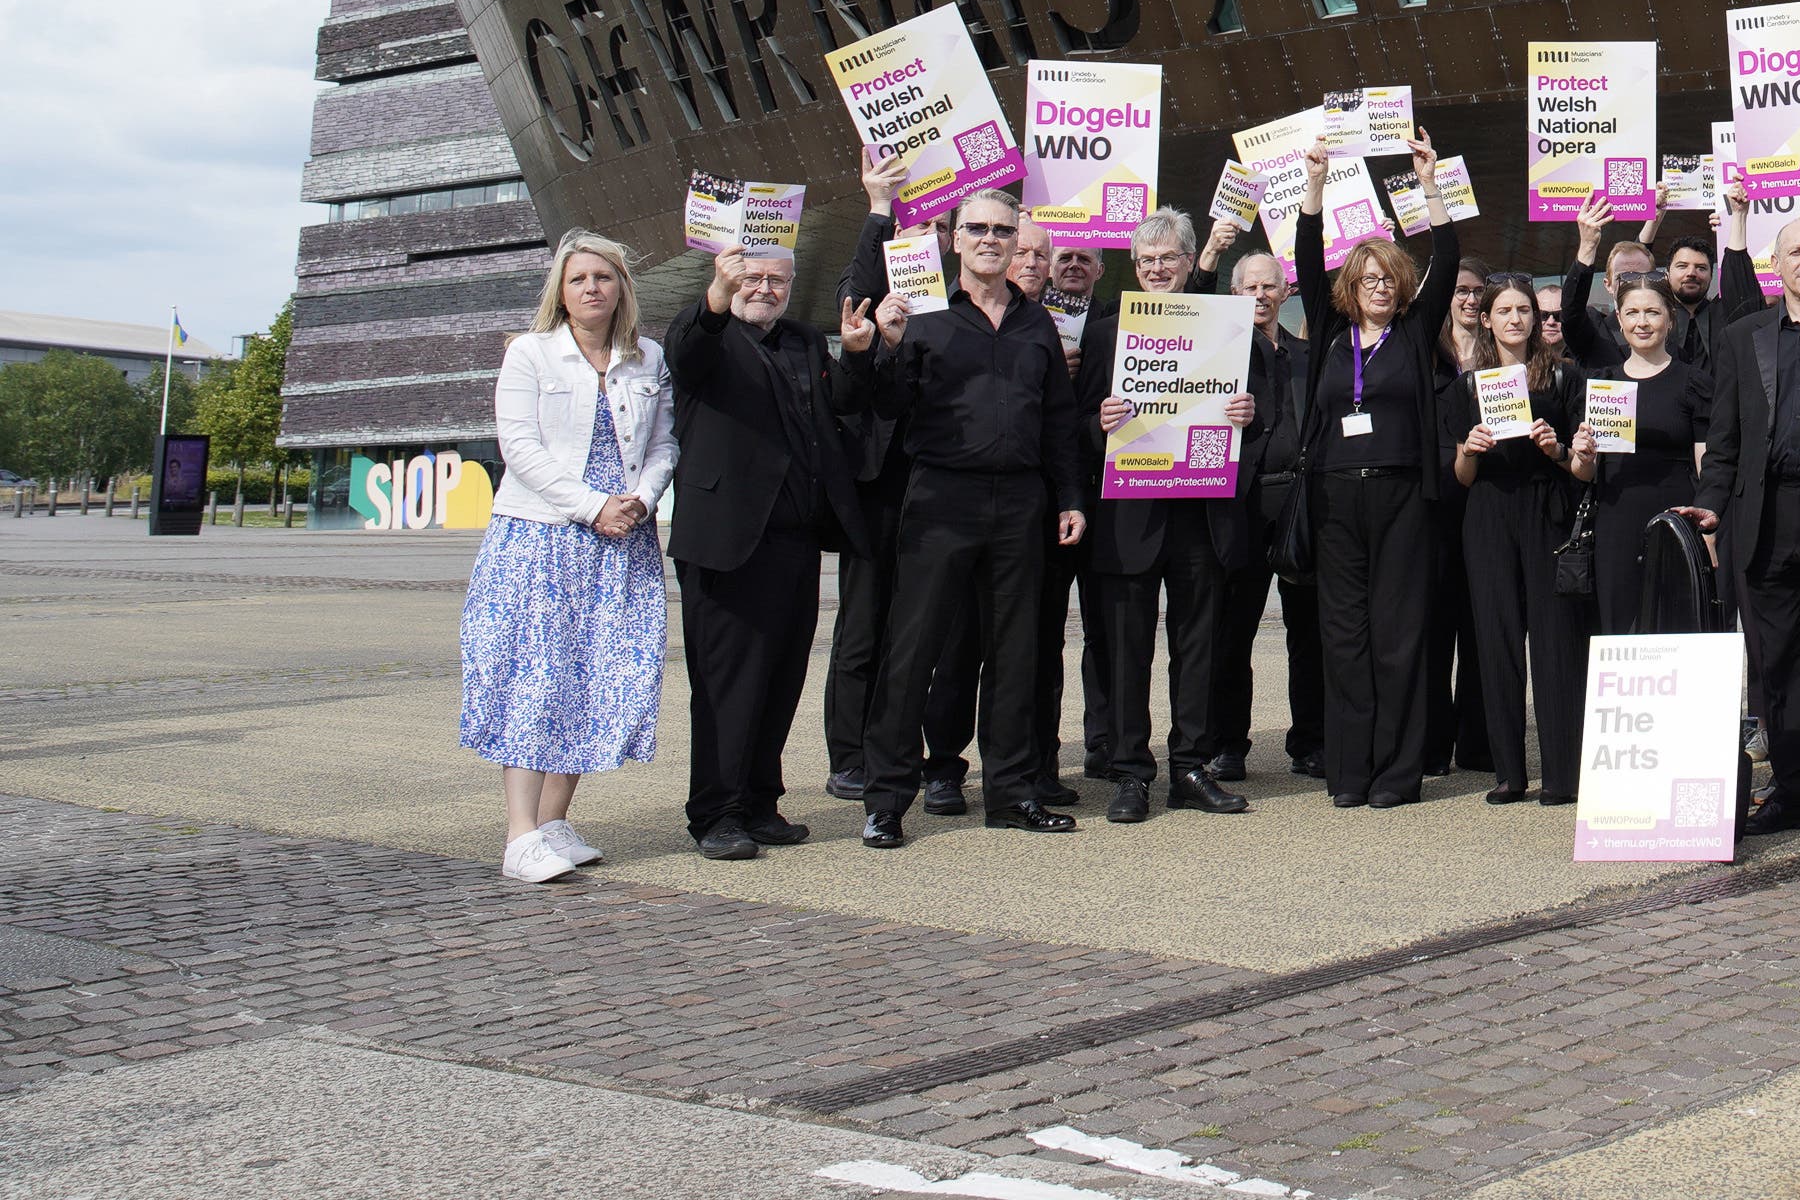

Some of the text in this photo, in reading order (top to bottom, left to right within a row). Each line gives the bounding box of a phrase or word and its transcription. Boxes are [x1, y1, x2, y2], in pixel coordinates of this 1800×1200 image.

[876, 47, 896, 59] Union
[849, 57, 927, 101] Protect
[1537, 75, 1608, 91] Protect
[858, 85, 925, 121] Welsh
[1367, 100, 1404, 109] Protect
[1537, 96, 1597, 112] Welsh
[868, 94, 954, 142] National
[1036, 101, 1151, 133] Diogelu
[1368, 110, 1399, 120] Welsh
[1369, 121, 1410, 131] National
[1537, 117, 1617, 134] National
[878, 126, 941, 159] Opera
[1370, 132, 1401, 143] Opera
[1034, 135, 1112, 160] WNO
[1537, 138, 1596, 158] Opera
[1751, 158, 1796, 171] #WNOBalch
[1269, 167, 1303, 188] pera
[1434, 168, 1462, 180] rotect
[902, 172, 952, 199] #WNOProud
[920, 163, 1016, 211] themu.org/ProtectWNO
[1225, 172, 1259, 191] Protect
[1221, 182, 1250, 199] Welsh
[1442, 186, 1470, 199] ational
[1542, 185, 1590, 194] #WNOProud
[690, 200, 717, 213] Diogelu
[747, 197, 793, 209] Protect
[1218, 190, 1256, 212] National
[1446, 199, 1465, 210] pera
[689, 209, 711, 221] Opera
[1037, 209, 1086, 219] #WNOBalch
[1215, 200, 1243, 217] Opera
[745, 210, 783, 221] Welsh
[689, 218, 735, 235] Cenedlaethol
[689, 226, 711, 238] Cymru
[743, 223, 794, 234] National
[1046, 228, 1133, 240] themu.org/ProtectW
[742, 235, 779, 247] Opera
[889, 250, 930, 264] Protect
[891, 263, 926, 277] Welsh
[893, 273, 940, 289] National
[900, 288, 929, 300] pera
[1163, 309, 1200, 317] Cerddorion
[1126, 334, 1193, 354] Diogelu
[1124, 356, 1178, 375] Opera
[1121, 377, 1238, 394] Cenedlaethol
[1480, 378, 1518, 392] Protect
[1482, 391, 1514, 404] Welsh
[1589, 394, 1628, 404] Protect
[1484, 401, 1526, 415] National
[1589, 406, 1621, 416] Welsh
[1486, 413, 1517, 426] Opera
[1588, 417, 1632, 428] National
[1120, 458, 1169, 466] #WNOBalch
[1128, 477, 1227, 489] themu.org/ProtectWNO
[365, 450, 462, 530] SIOP
[1639, 653, 1662, 661] Union
[1597, 669, 1678, 697] Fund
[1594, 706, 1654, 734] The
[1591, 744, 1659, 770] Arts
[1593, 815, 1651, 825] #WNOProud
[1603, 837, 1722, 850] themu.org/ProtectWNO
